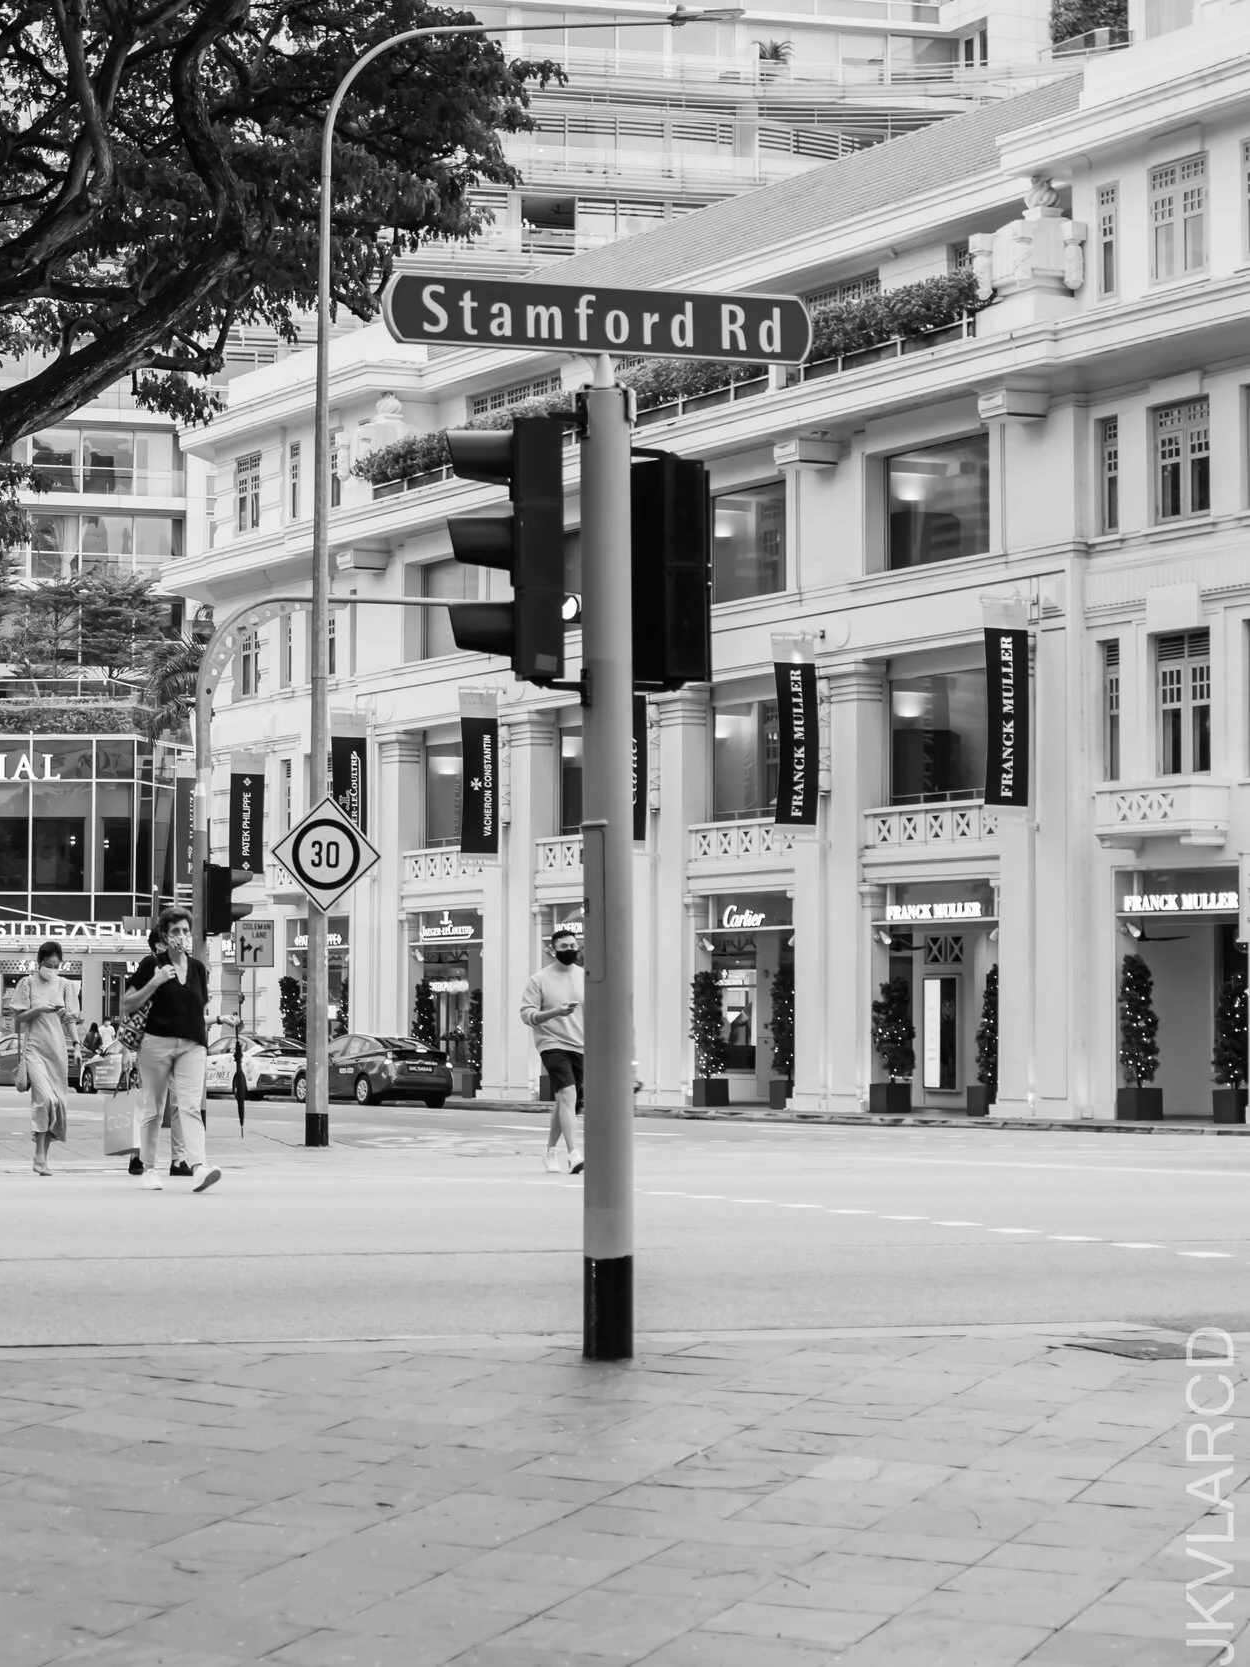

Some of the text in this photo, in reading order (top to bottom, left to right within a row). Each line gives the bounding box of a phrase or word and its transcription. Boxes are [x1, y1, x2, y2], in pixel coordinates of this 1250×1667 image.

[421, 284, 782, 354] Stamford Rd
[1000, 636, 1014, 798] FRANCK MULLER
[790, 669, 805, 818] FRANCK MULLER
[483, 734, 493, 837] VACHERON CONSTANTIN
[242, 791, 251, 856] PATEK PHILIPPE
[310, 840, 340, 868] 30
[722, 904, 766, 928] Cartier
[886, 902, 981, 920] FRANCK MULLER
[1124, 892, 1239, 911] FRANCK MULLER
[252, 931, 267, 939] LANE
